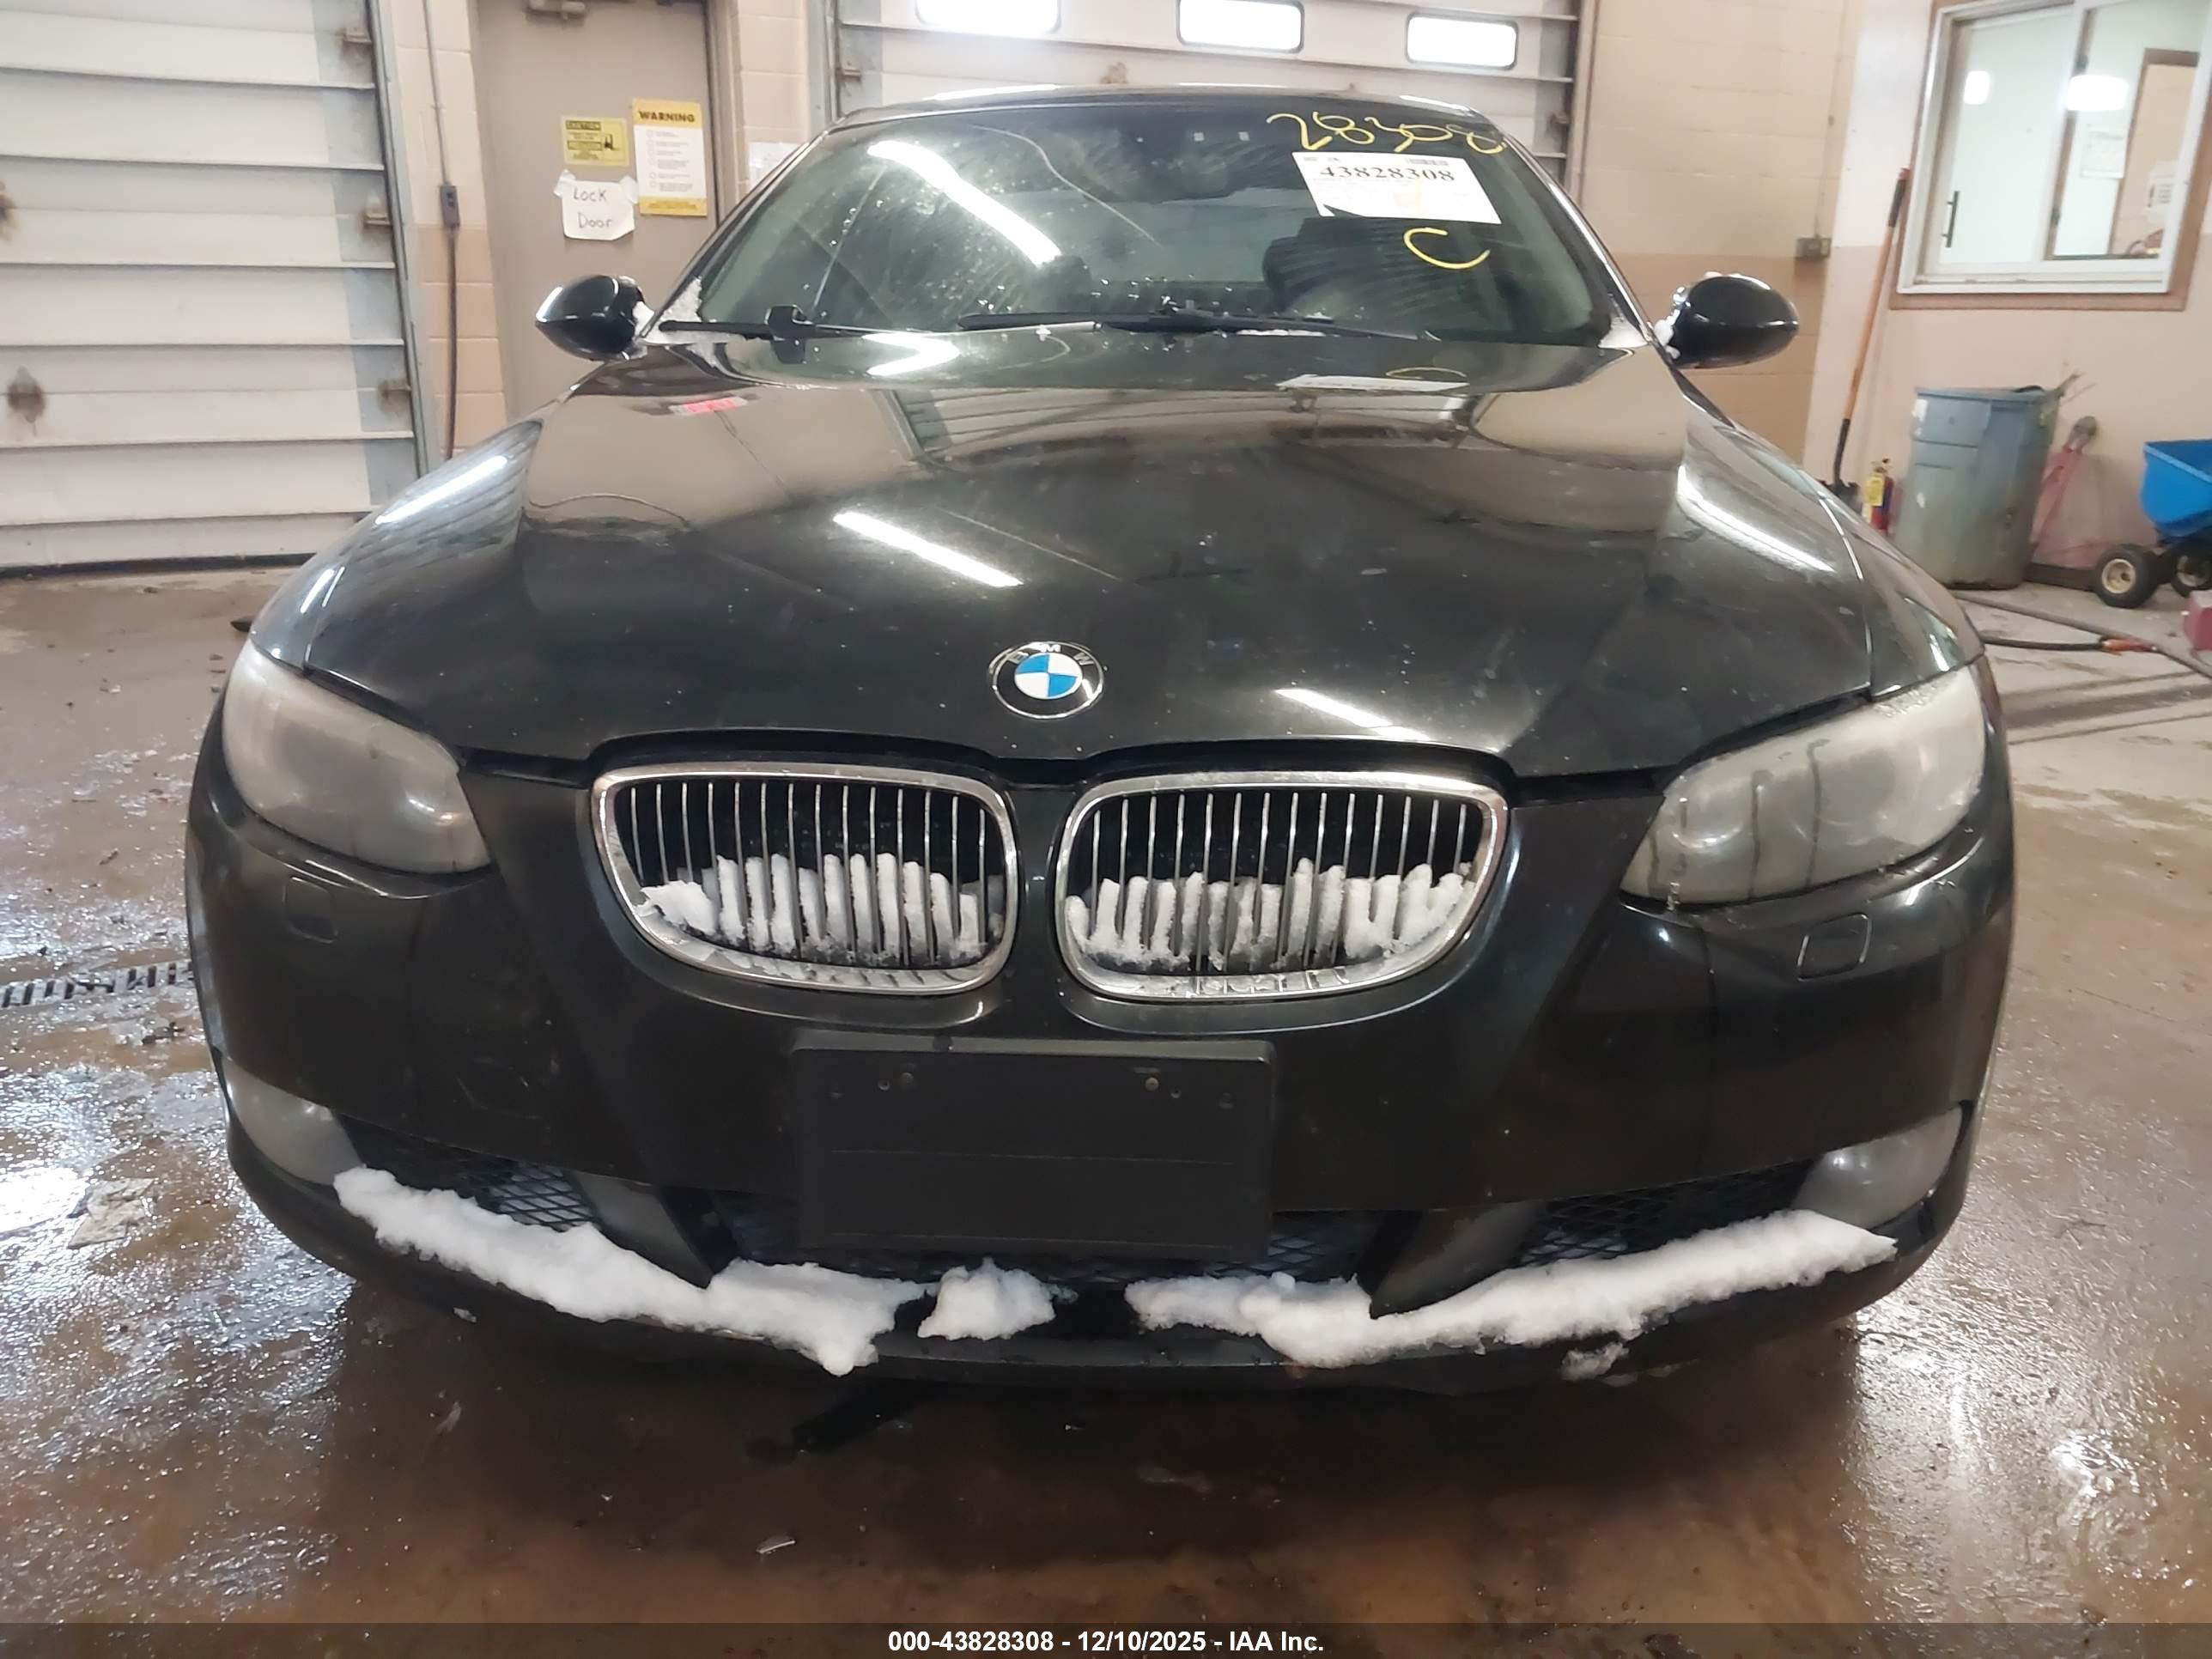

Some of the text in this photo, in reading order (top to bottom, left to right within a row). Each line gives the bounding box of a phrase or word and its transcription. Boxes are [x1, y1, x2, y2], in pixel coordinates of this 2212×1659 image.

[638, 110, 696, 123] WARNING
[1320, 165, 1455, 182] 43828308
[577, 211, 612, 228] Door
[1403, 227, 1491, 270] C
